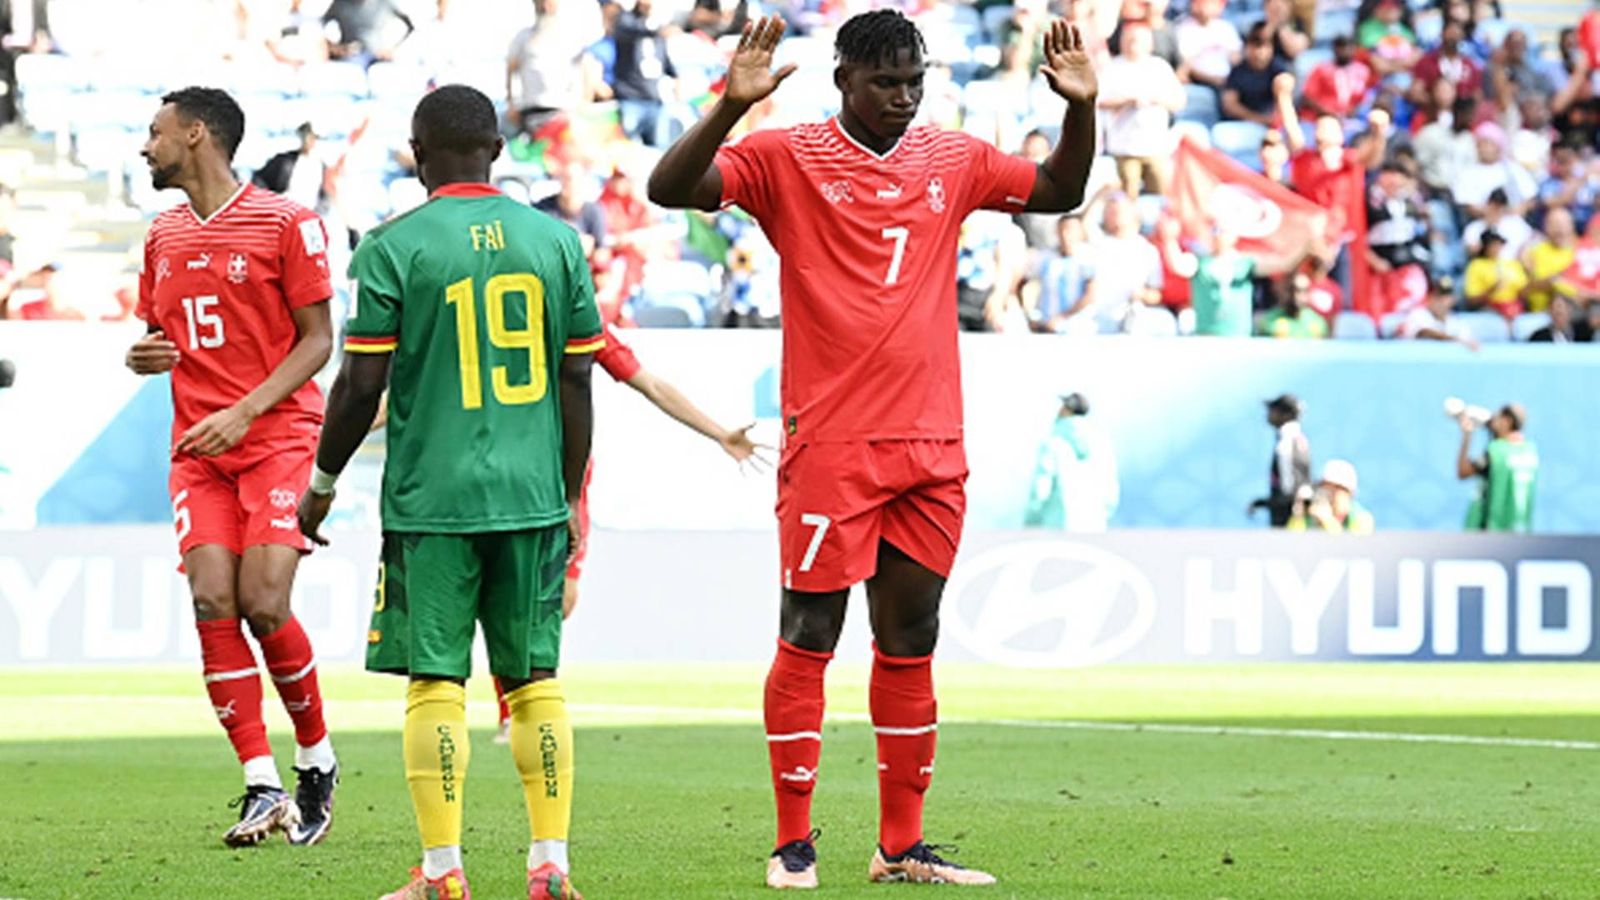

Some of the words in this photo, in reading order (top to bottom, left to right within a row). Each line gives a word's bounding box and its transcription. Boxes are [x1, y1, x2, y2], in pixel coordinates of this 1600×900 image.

[469, 219, 507, 252] FAÏ
[880, 226, 910, 286] 7
[182, 294, 227, 351] 15
[445, 273, 548, 410] 19
[799, 513, 832, 573] 7
[1183, 557, 1593, 655] HYUND
